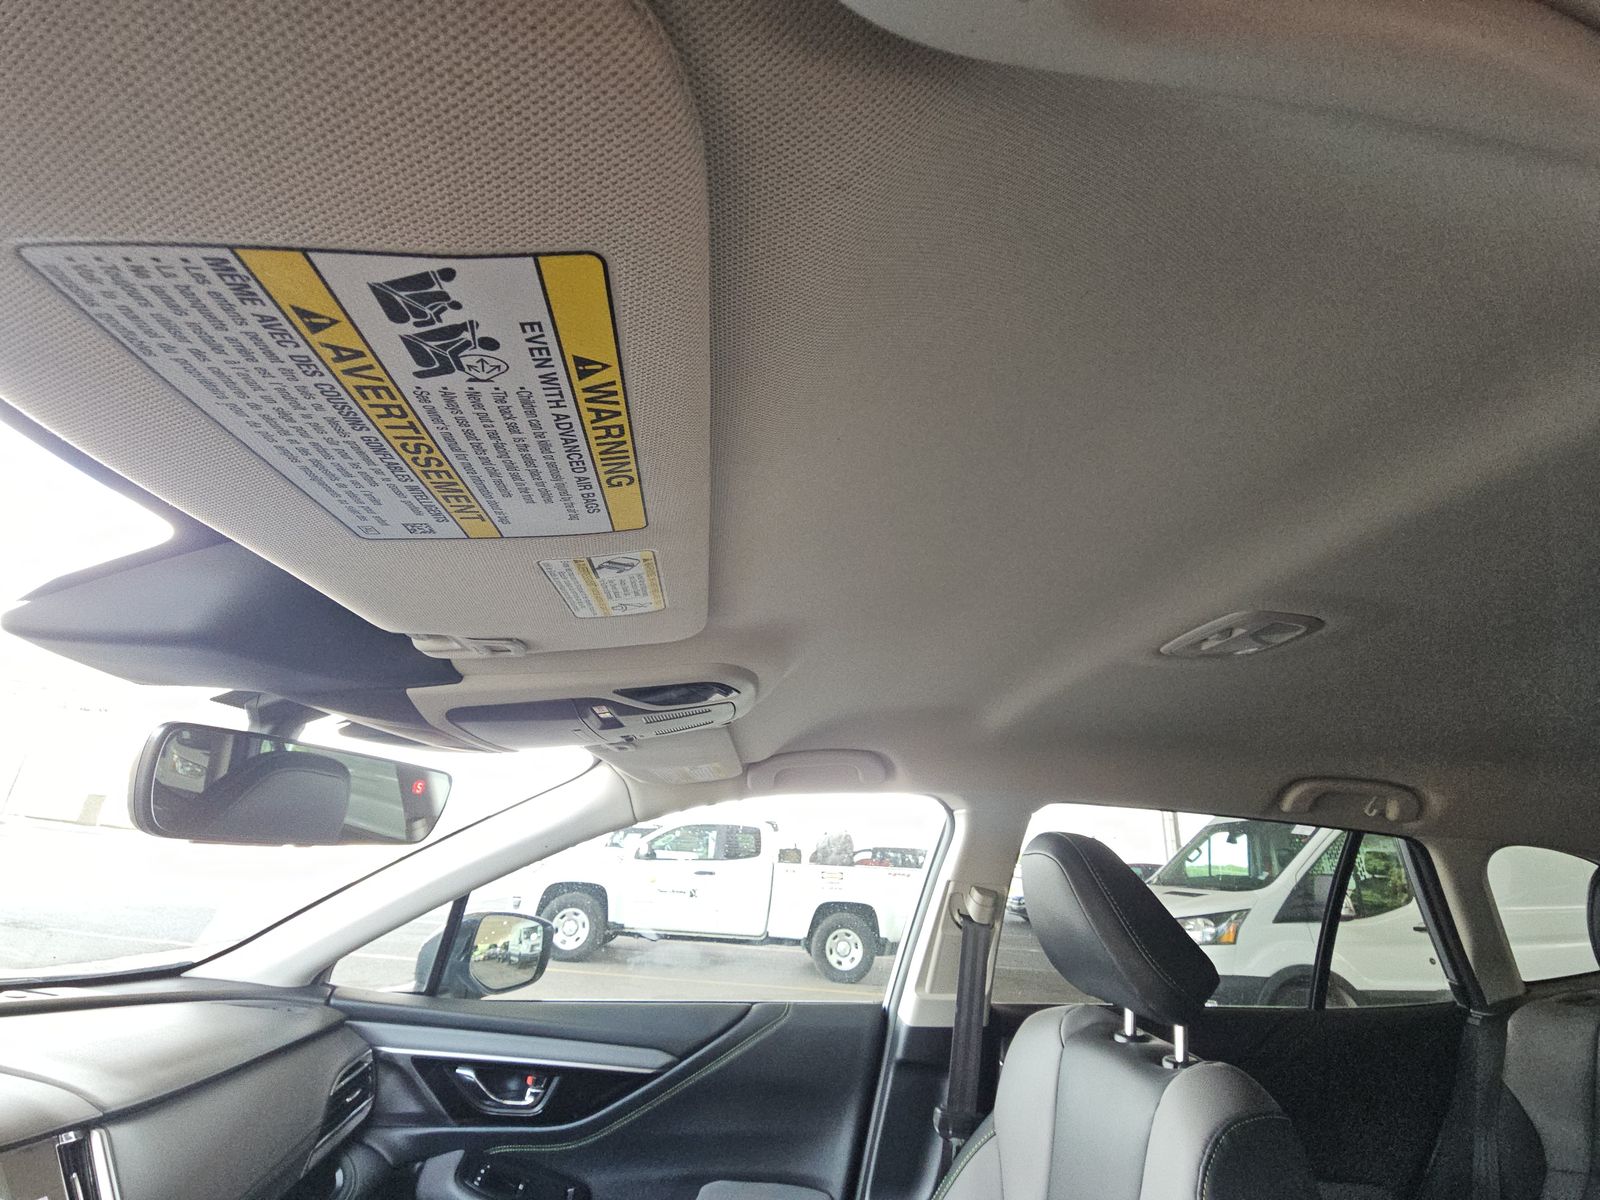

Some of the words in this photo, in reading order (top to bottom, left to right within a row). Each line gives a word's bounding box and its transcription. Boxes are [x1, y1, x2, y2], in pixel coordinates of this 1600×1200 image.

[181, 266, 213, 284] Les
[204, 291, 250, 326] enfants
[239, 331, 287, 363] peuvent
[518, 320, 555, 368] EVEN
[200, 256, 272, 306] MÊME
[250, 313, 302, 348] AVEC
[286, 354, 326, 377] DES
[311, 383, 372, 431] COUSSINS
[358, 436, 415, 482] GONFLABLES
[251, 366, 277, 378] est
[411, 390, 432, 403] See
[489, 391, 509, 404] The
[536, 371, 567, 408] WITH
[437, 390, 463, 414] Always
[464, 391, 486, 410] Never
[421, 404, 450, 430] owner's
[471, 412, 495, 423] put
[496, 405, 518, 421] back
[514, 390, 538, 418] Children
[527, 419, 542, 430] can
[452, 416, 471, 427] use
[503, 421, 524, 434] seat
[318, 341, 486, 522] AVERTISSEMENT
[460, 428, 481, 441] seat
[581, 380, 635, 489] WARNING
[439, 431, 466, 452] manual
[468, 441, 488, 455] belts
[485, 429, 510, 459] rear-facing
[514, 443, 531, 452] the
[551, 412, 588, 473] ADVANCED
[477, 456, 496, 465] and
[501, 459, 520, 471] child
[519, 453, 539, 468] safest
[507, 471, 525, 481] seat
[574, 475, 593, 491] AIR
[580, 492, 601, 513] BAGS
